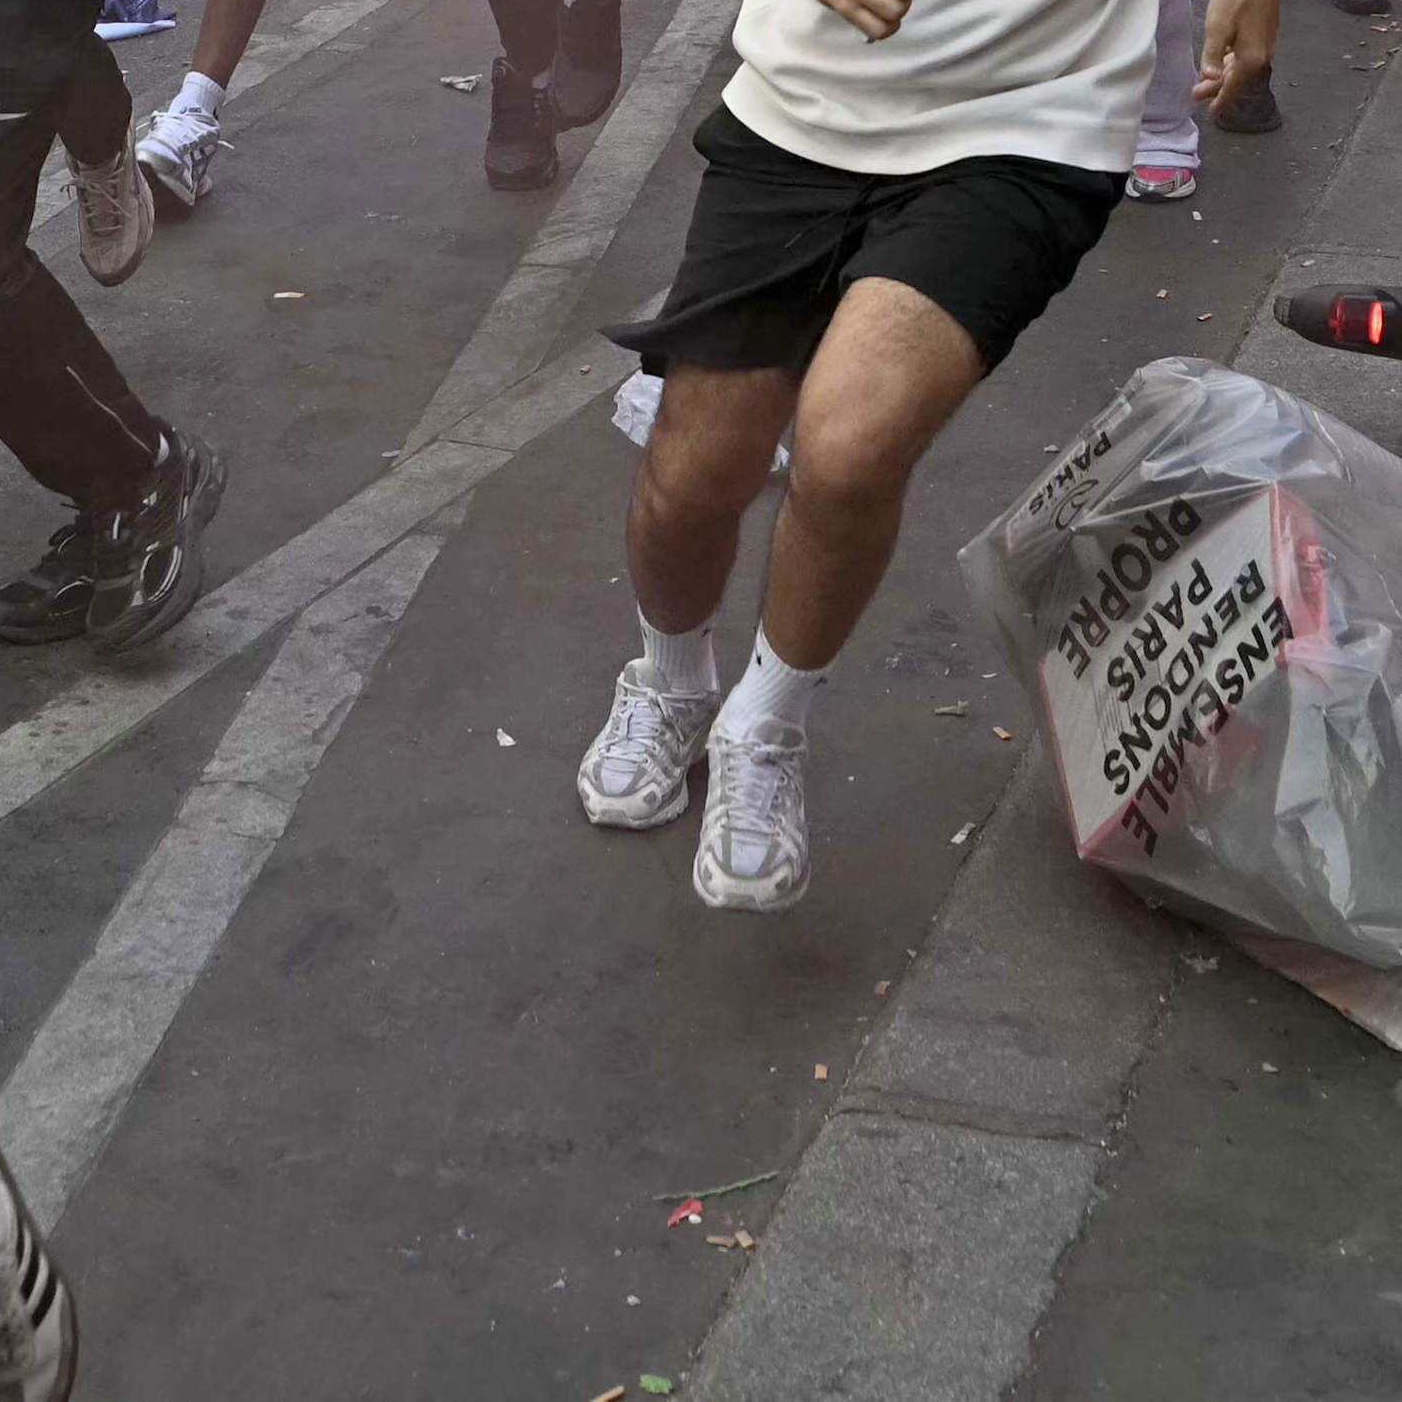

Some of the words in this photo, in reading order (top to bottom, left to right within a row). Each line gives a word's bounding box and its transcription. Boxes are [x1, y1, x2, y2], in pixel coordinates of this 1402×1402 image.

[1058, 497, 1203, 681] PROPRE
[1104, 558, 1267, 796] RENDONS
[1107, 557, 1213, 703] PARIS
[1121, 596, 1296, 858] ENSEMBLE
